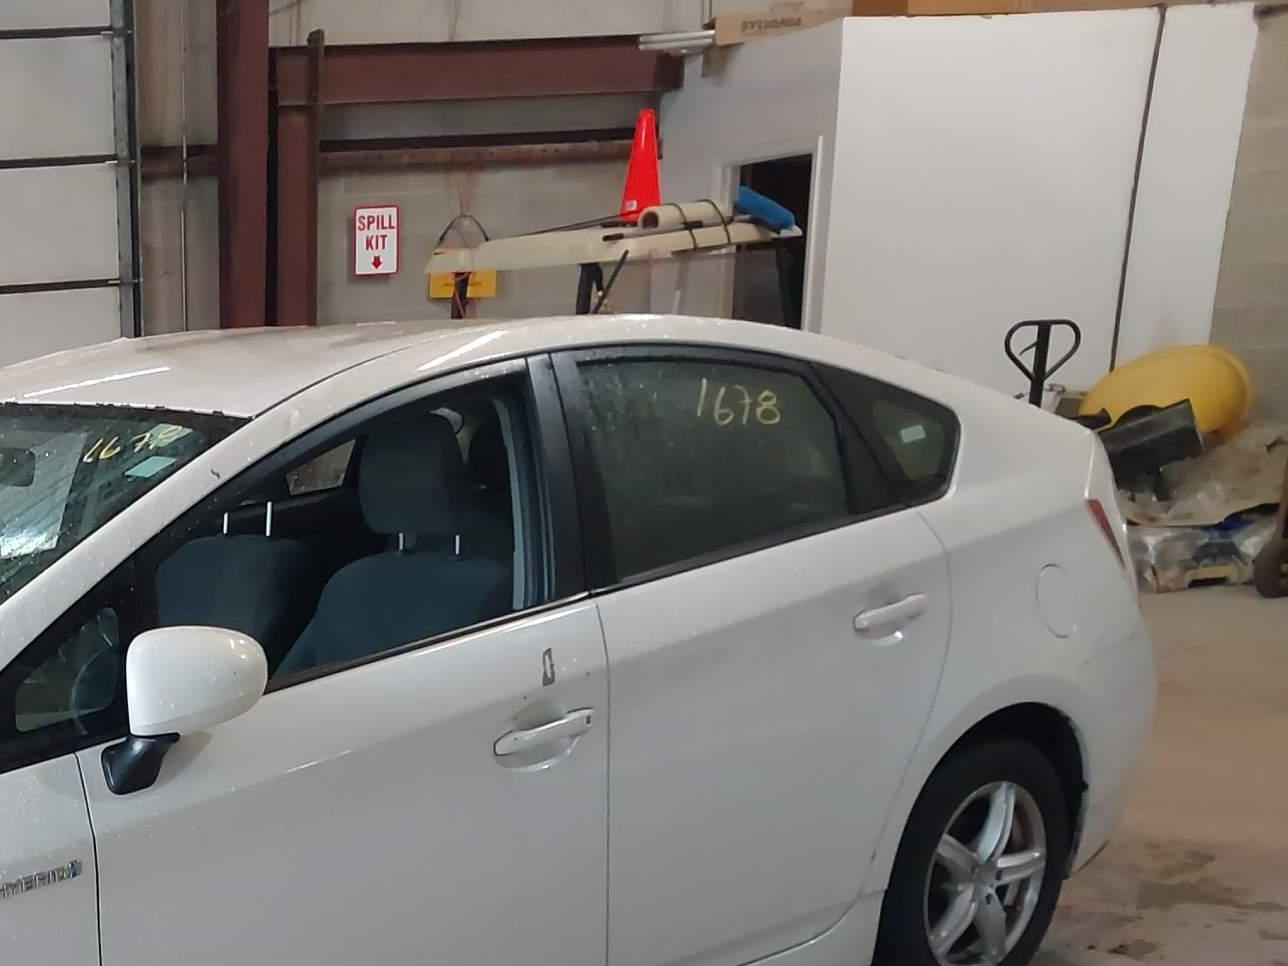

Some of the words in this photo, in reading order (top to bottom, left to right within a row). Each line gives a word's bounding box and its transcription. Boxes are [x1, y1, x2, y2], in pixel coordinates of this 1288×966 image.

[358, 214, 396, 231] SPILL
[365, 234, 388, 251] KIT
[696, 377, 781, 425] 1678
